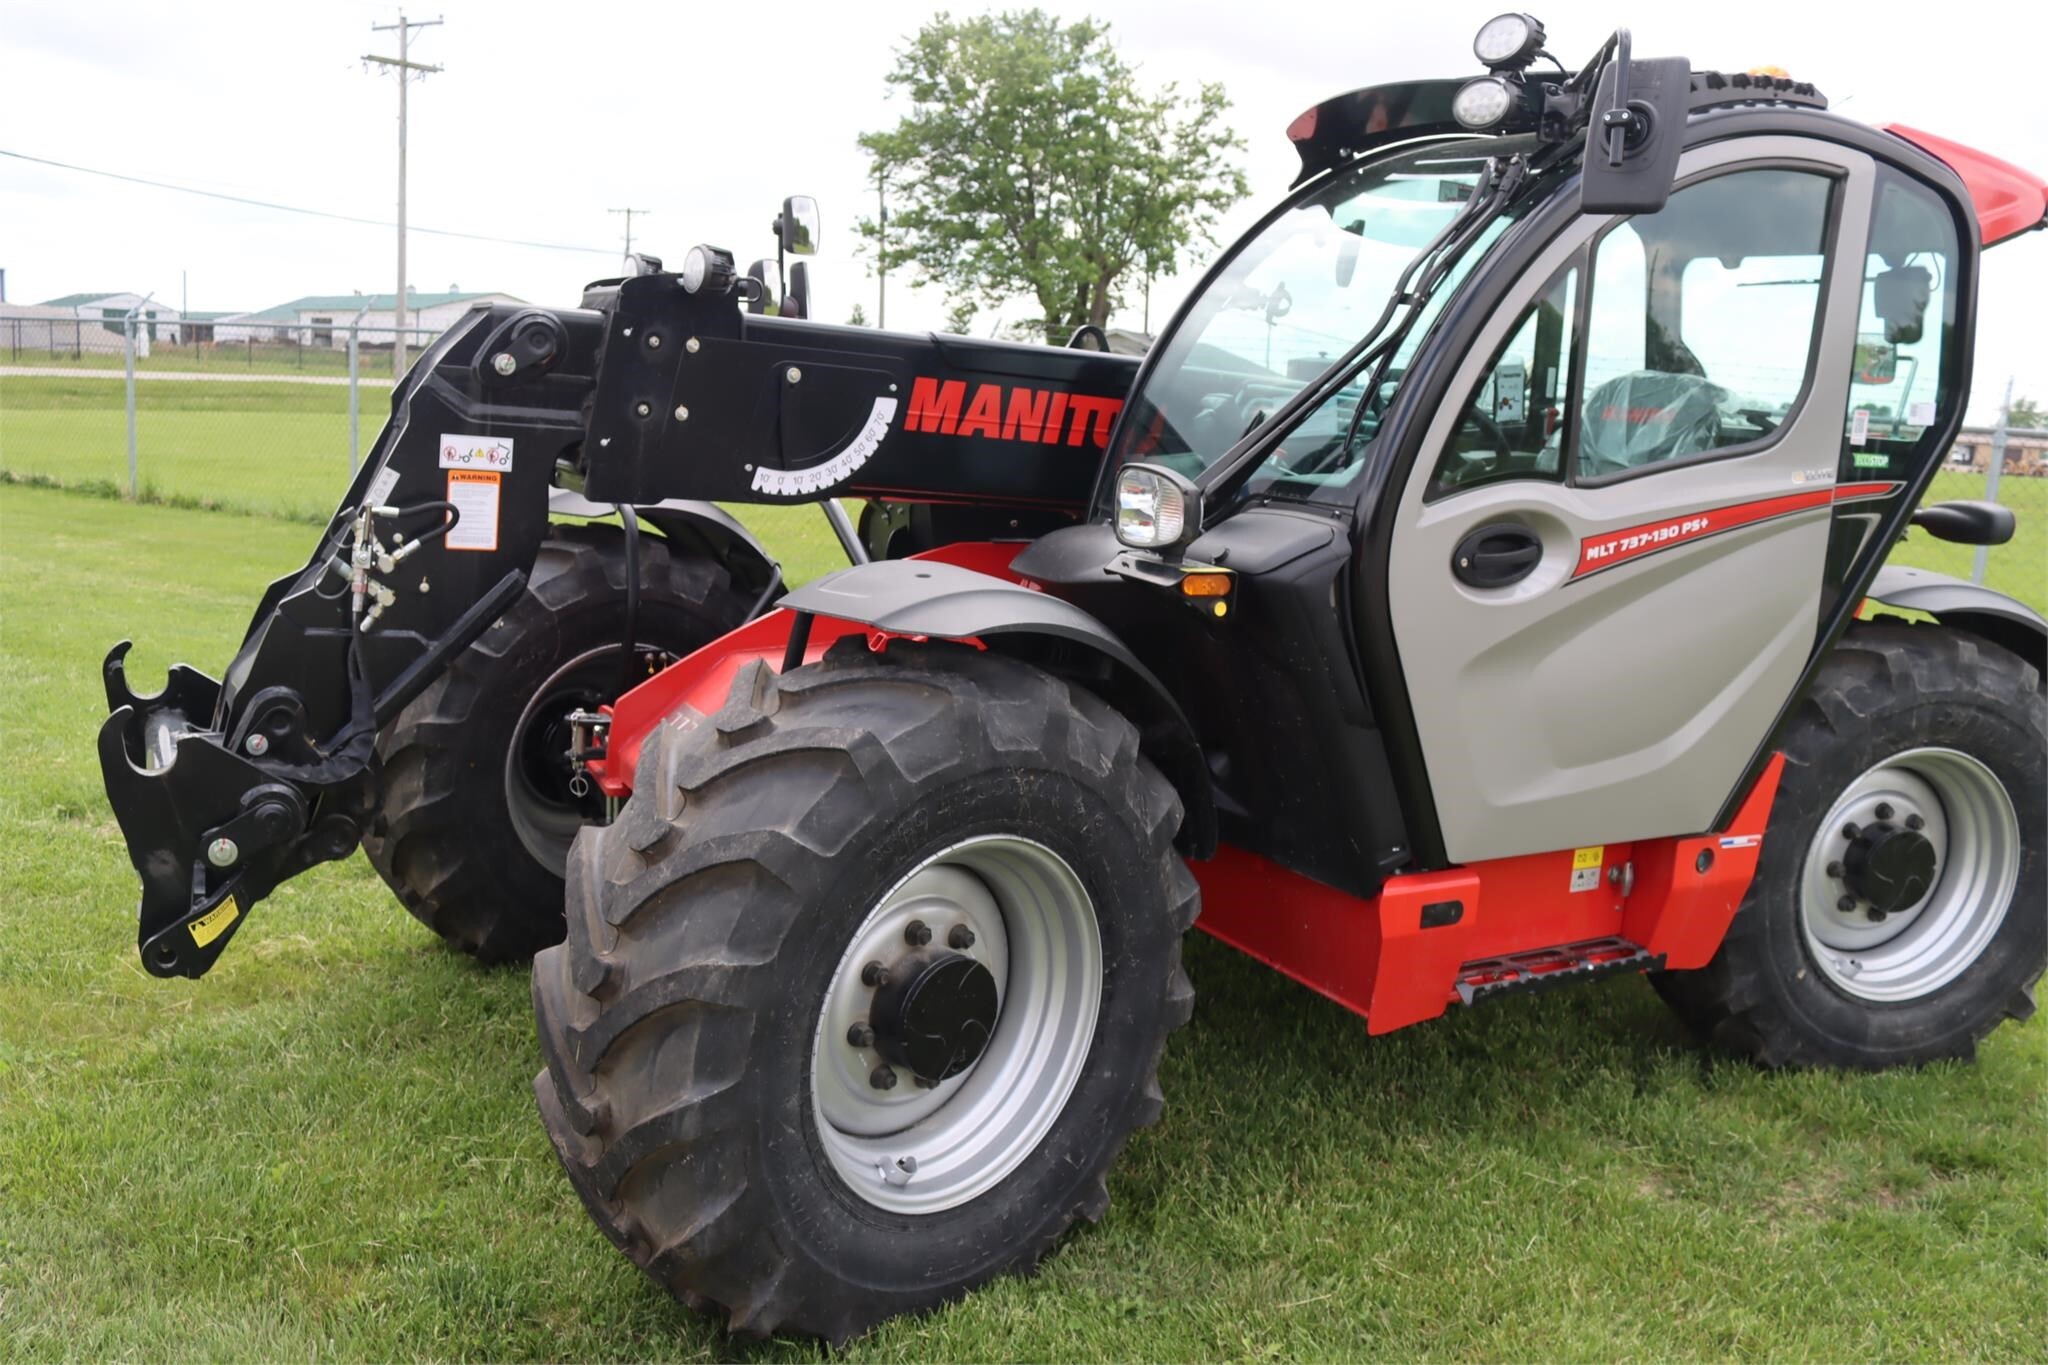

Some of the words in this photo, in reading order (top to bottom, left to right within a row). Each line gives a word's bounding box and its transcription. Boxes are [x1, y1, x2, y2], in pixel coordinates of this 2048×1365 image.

[460, 474, 497, 482] WARNING
[1586, 541, 1618, 560] MLT
[1620, 525, 1679, 552] 737-130
